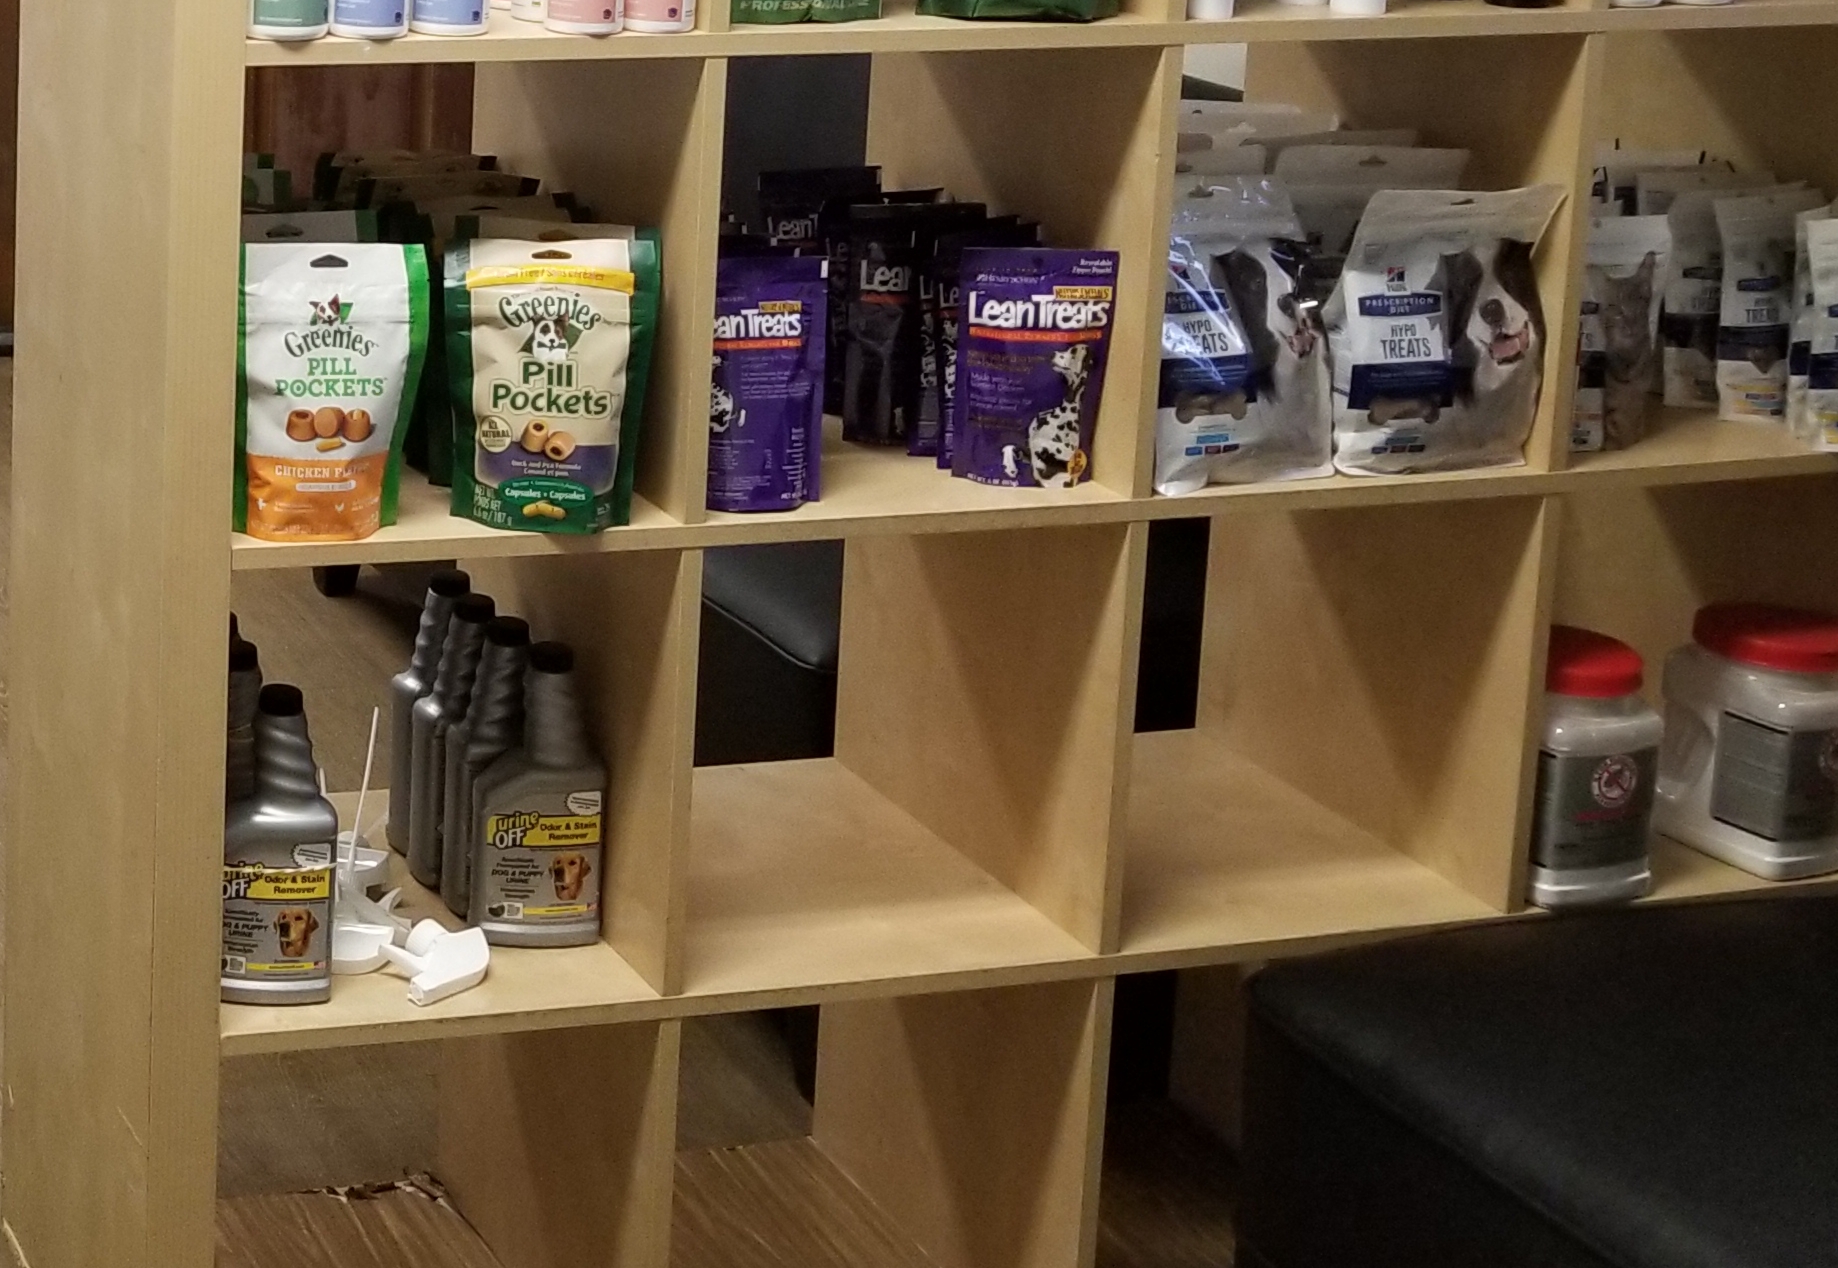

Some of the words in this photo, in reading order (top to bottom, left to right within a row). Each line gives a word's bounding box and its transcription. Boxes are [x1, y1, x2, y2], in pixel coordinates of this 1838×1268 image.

[767, 214, 819, 240] LeanT
[1180, 301, 1198, 311] DIE
[1365, 296, 1435, 307] PRESCRIPTION
[498, 292, 602, 331] Greenies
[1390, 305, 1410, 314] DIET
[713, 308, 802, 339] eanTreats
[1183, 319, 1212, 333] HYPO
[1390, 323, 1417, 338] HYPO
[283, 325, 375, 358] Greenies
[1380, 337, 1432, 360] TREATS
[307, 357, 357, 376] PILL
[522, 360, 573, 388] Pill
[274, 377, 384, 397] POCKETS
[492, 383, 609, 415] Pockets
[481, 429, 511, 439] NATURAL
[275, 464, 330, 479] CHICKEN
[504, 487, 542, 500] Capsules
[549, 489, 587, 502] Capsules
[497, 812, 539, 831] urine
[540, 823, 563, 832] Odor
[565, 822, 571, 831] &
[574, 821, 598, 830] Stain
[495, 827, 525, 849] OFF
[548, 832, 589, 841] Remover
[264, 875, 289, 884] Odor
[290, 876, 298, 884] &
[301, 874, 326, 883] Stain
[273, 885, 317, 894] Remover
